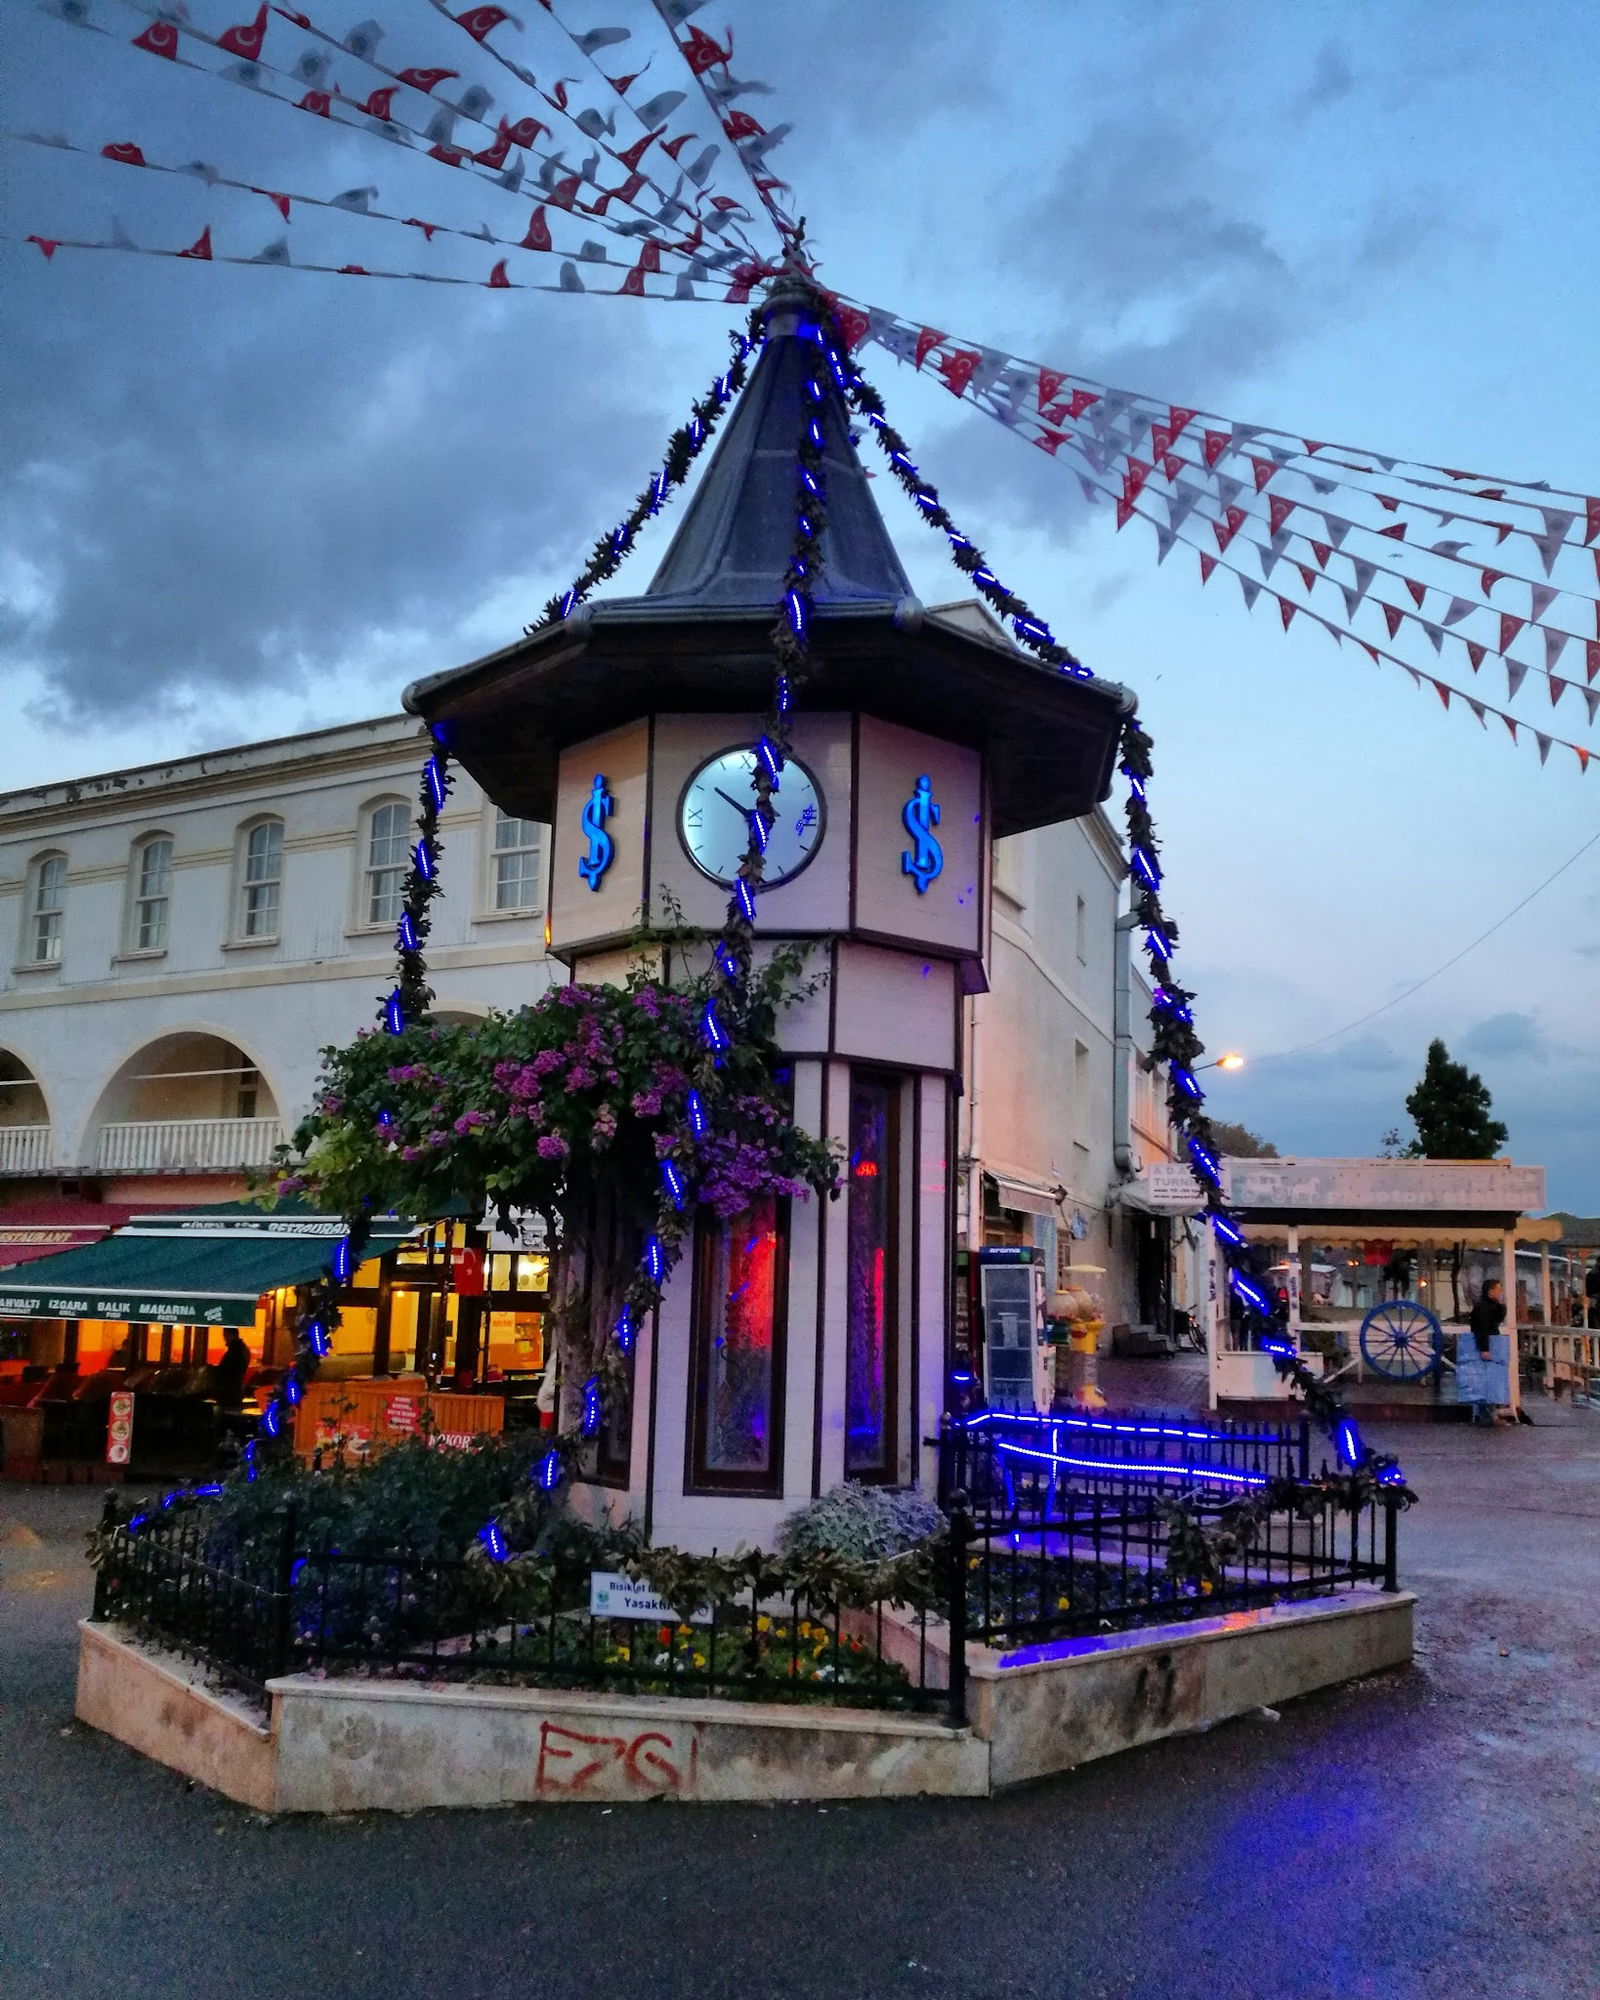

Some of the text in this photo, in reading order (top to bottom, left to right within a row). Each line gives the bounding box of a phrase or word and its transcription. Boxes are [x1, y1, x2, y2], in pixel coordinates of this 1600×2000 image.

[268, 1222, 351, 1235] RESTAURAN
[0, 1231, 72, 1242] ESTAURANT
[139, 1303, 195, 1316] MAKARNA
[428, 1432, 476, 1449] KOKOR
